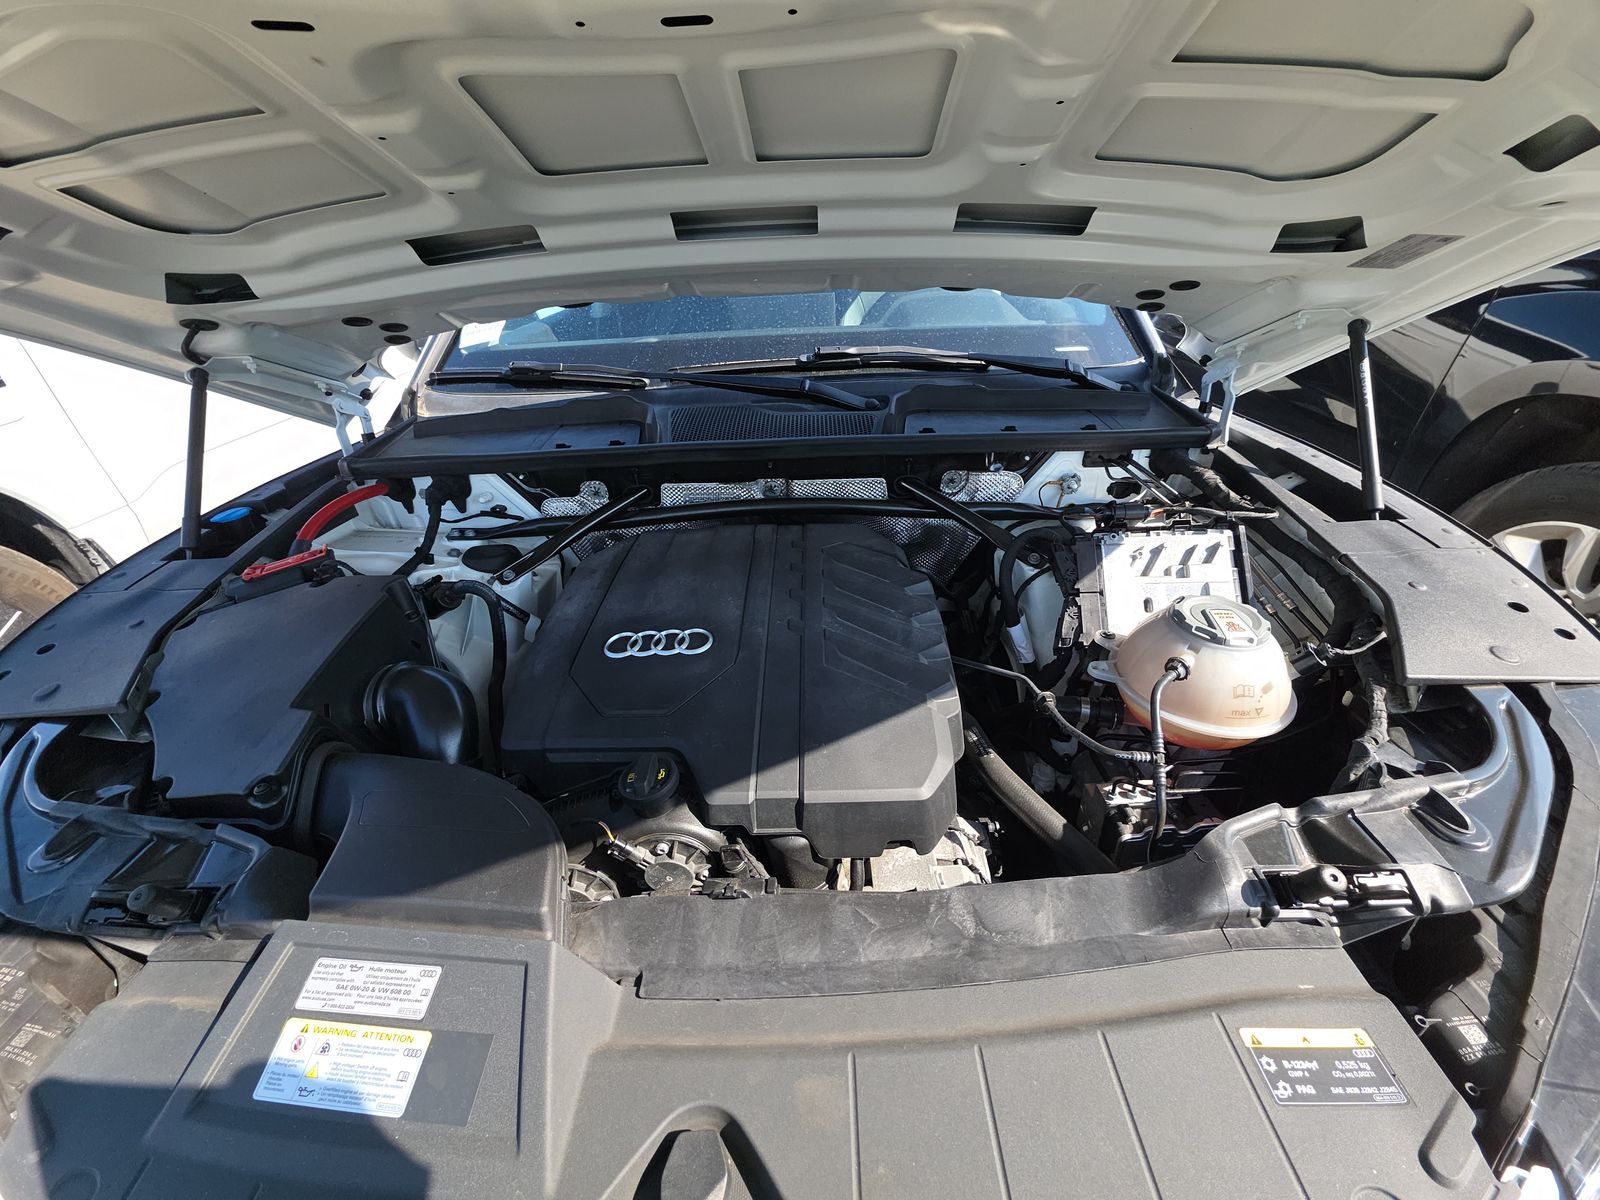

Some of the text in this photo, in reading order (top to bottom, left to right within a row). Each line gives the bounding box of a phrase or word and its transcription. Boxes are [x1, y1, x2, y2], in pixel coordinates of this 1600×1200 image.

[313, 1026, 414, 1043] WARNING ATTENTION
[1282, 1060, 1320, 1070] R-1234yf
[1335, 1060, 1371, 1070] 0,525 kg
[1295, 1084, 1317, 1094] PAG
